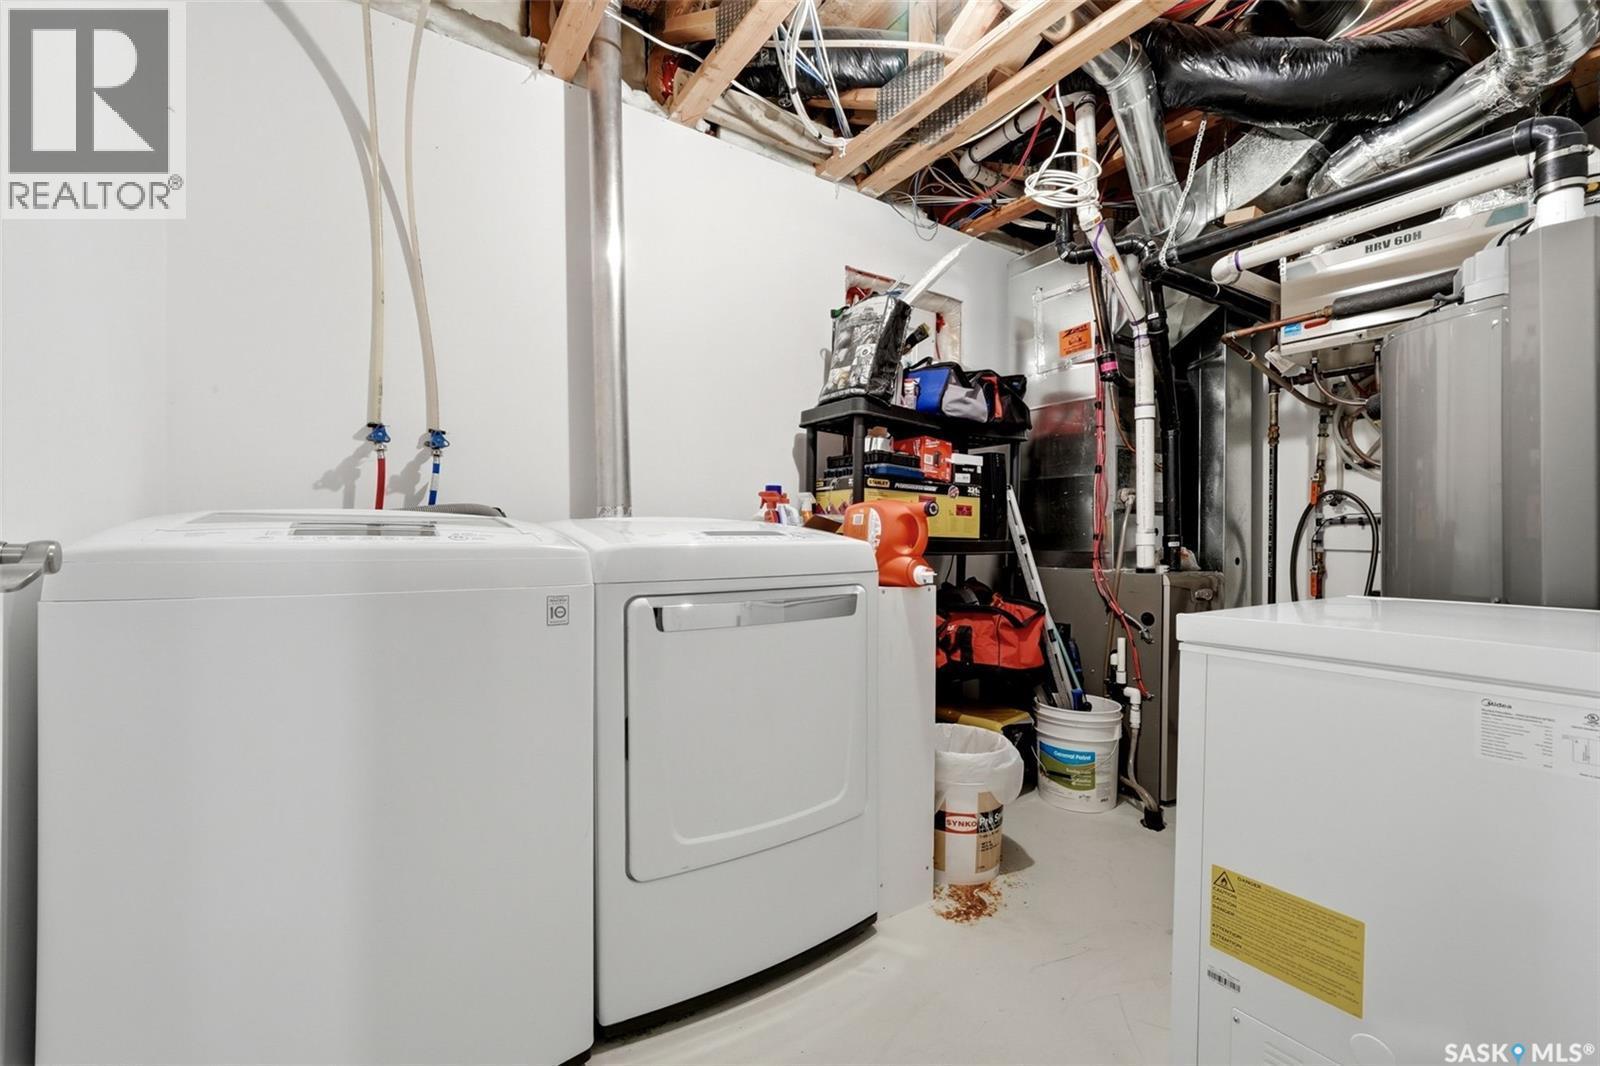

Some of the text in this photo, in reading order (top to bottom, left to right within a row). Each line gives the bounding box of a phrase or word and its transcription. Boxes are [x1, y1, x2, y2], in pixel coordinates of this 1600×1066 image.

[1365, 230, 1422, 254] HRV 60H
[946, 819, 978, 828] SYNKO
[1212, 886, 1238, 900] CAUTION
[1212, 895, 1238, 908] CAUTION
[1212, 923, 1243, 940] ATTENTION
[1212, 932, 1243, 949] ATTENTION
